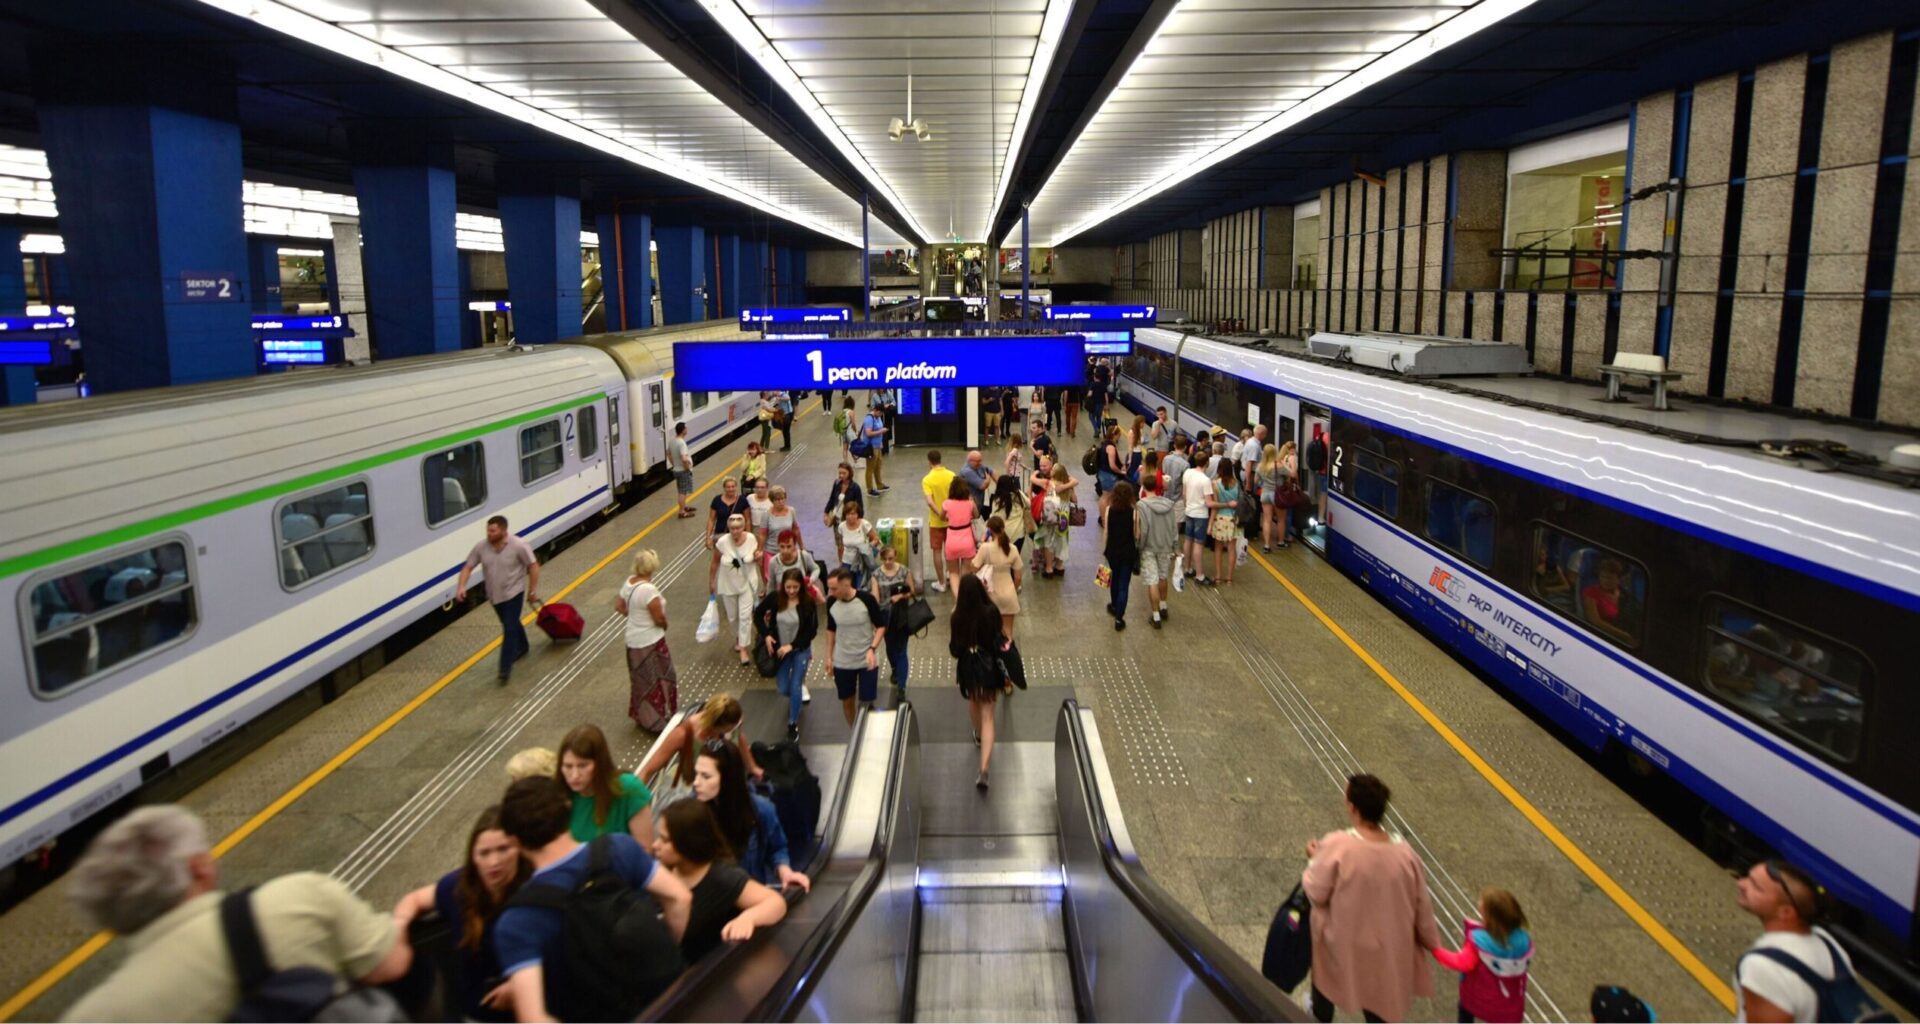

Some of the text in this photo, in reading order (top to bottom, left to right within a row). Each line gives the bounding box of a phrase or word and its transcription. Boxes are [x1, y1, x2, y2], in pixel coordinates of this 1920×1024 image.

[186, 278, 231, 298] SEKTOR 2
[742, 310, 751, 322] 5
[841, 309, 849, 321] 1
[1045, 305, 1051, 318] 1
[1145, 306, 1155, 318] 7
[333, 315, 342, 328] 3
[807, 351, 956, 384] 1 peron platform
[564, 413, 575, 441] 2
[1335, 445, 1343, 467] 2
[1467, 593, 1492, 613] PKP
[1493, 609, 1562, 657] INTERCITY
